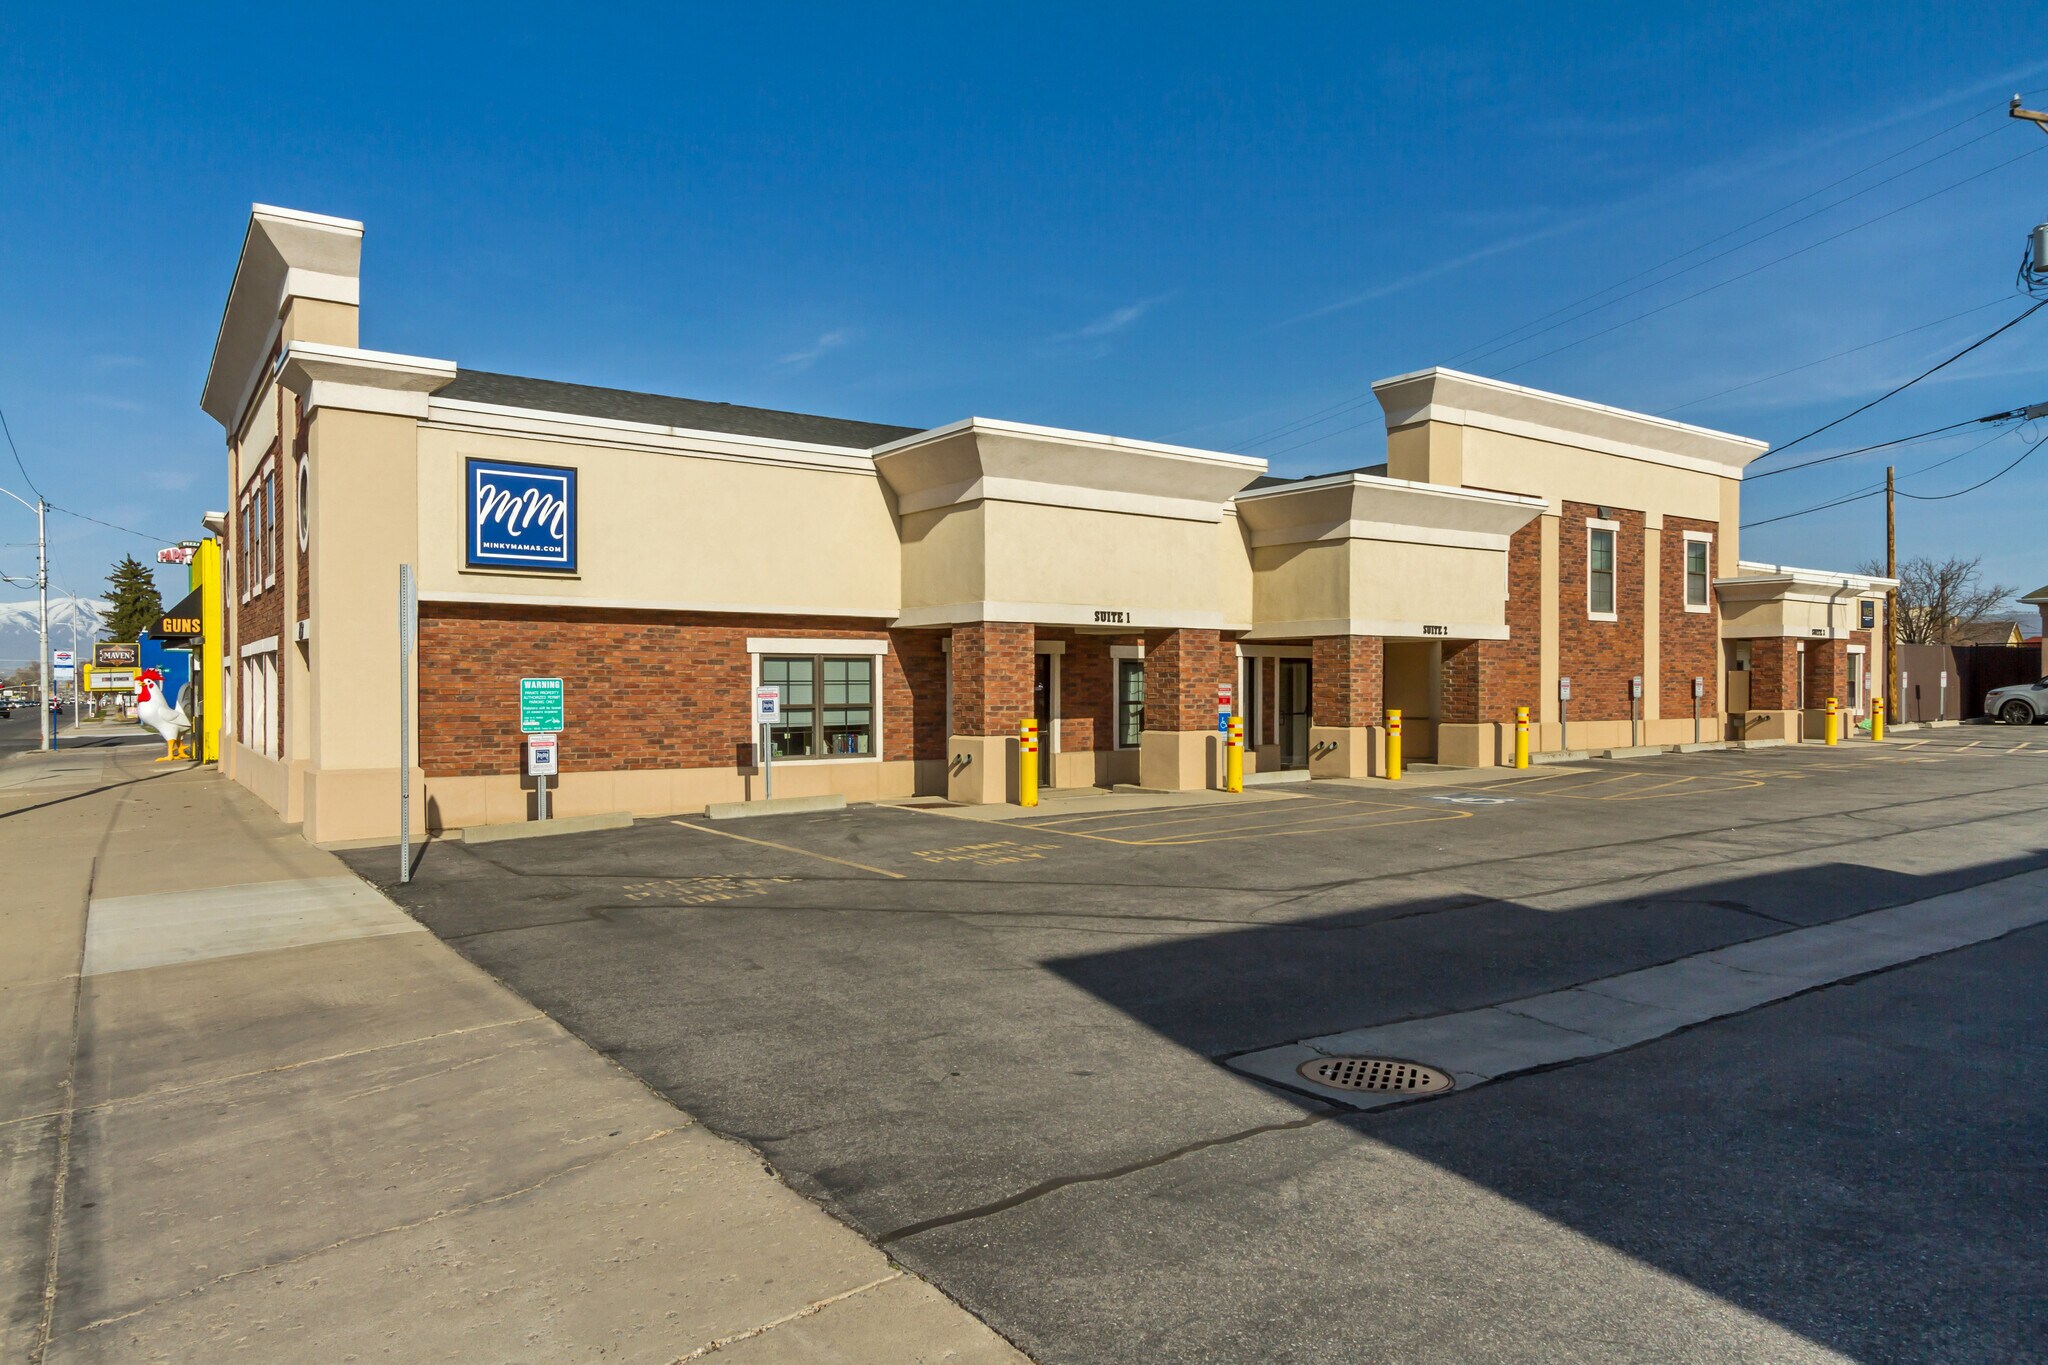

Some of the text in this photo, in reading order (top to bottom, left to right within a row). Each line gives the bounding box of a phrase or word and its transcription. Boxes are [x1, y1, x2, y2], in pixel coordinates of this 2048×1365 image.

[483, 542, 562, 553] MINKYMAMAS.COM
[1094, 610, 1130, 623] SUITE 1
[163, 618, 201, 633] GUNS
[1423, 625, 1448, 635] SUITE 2
[524, 681, 560, 689] WARNING
